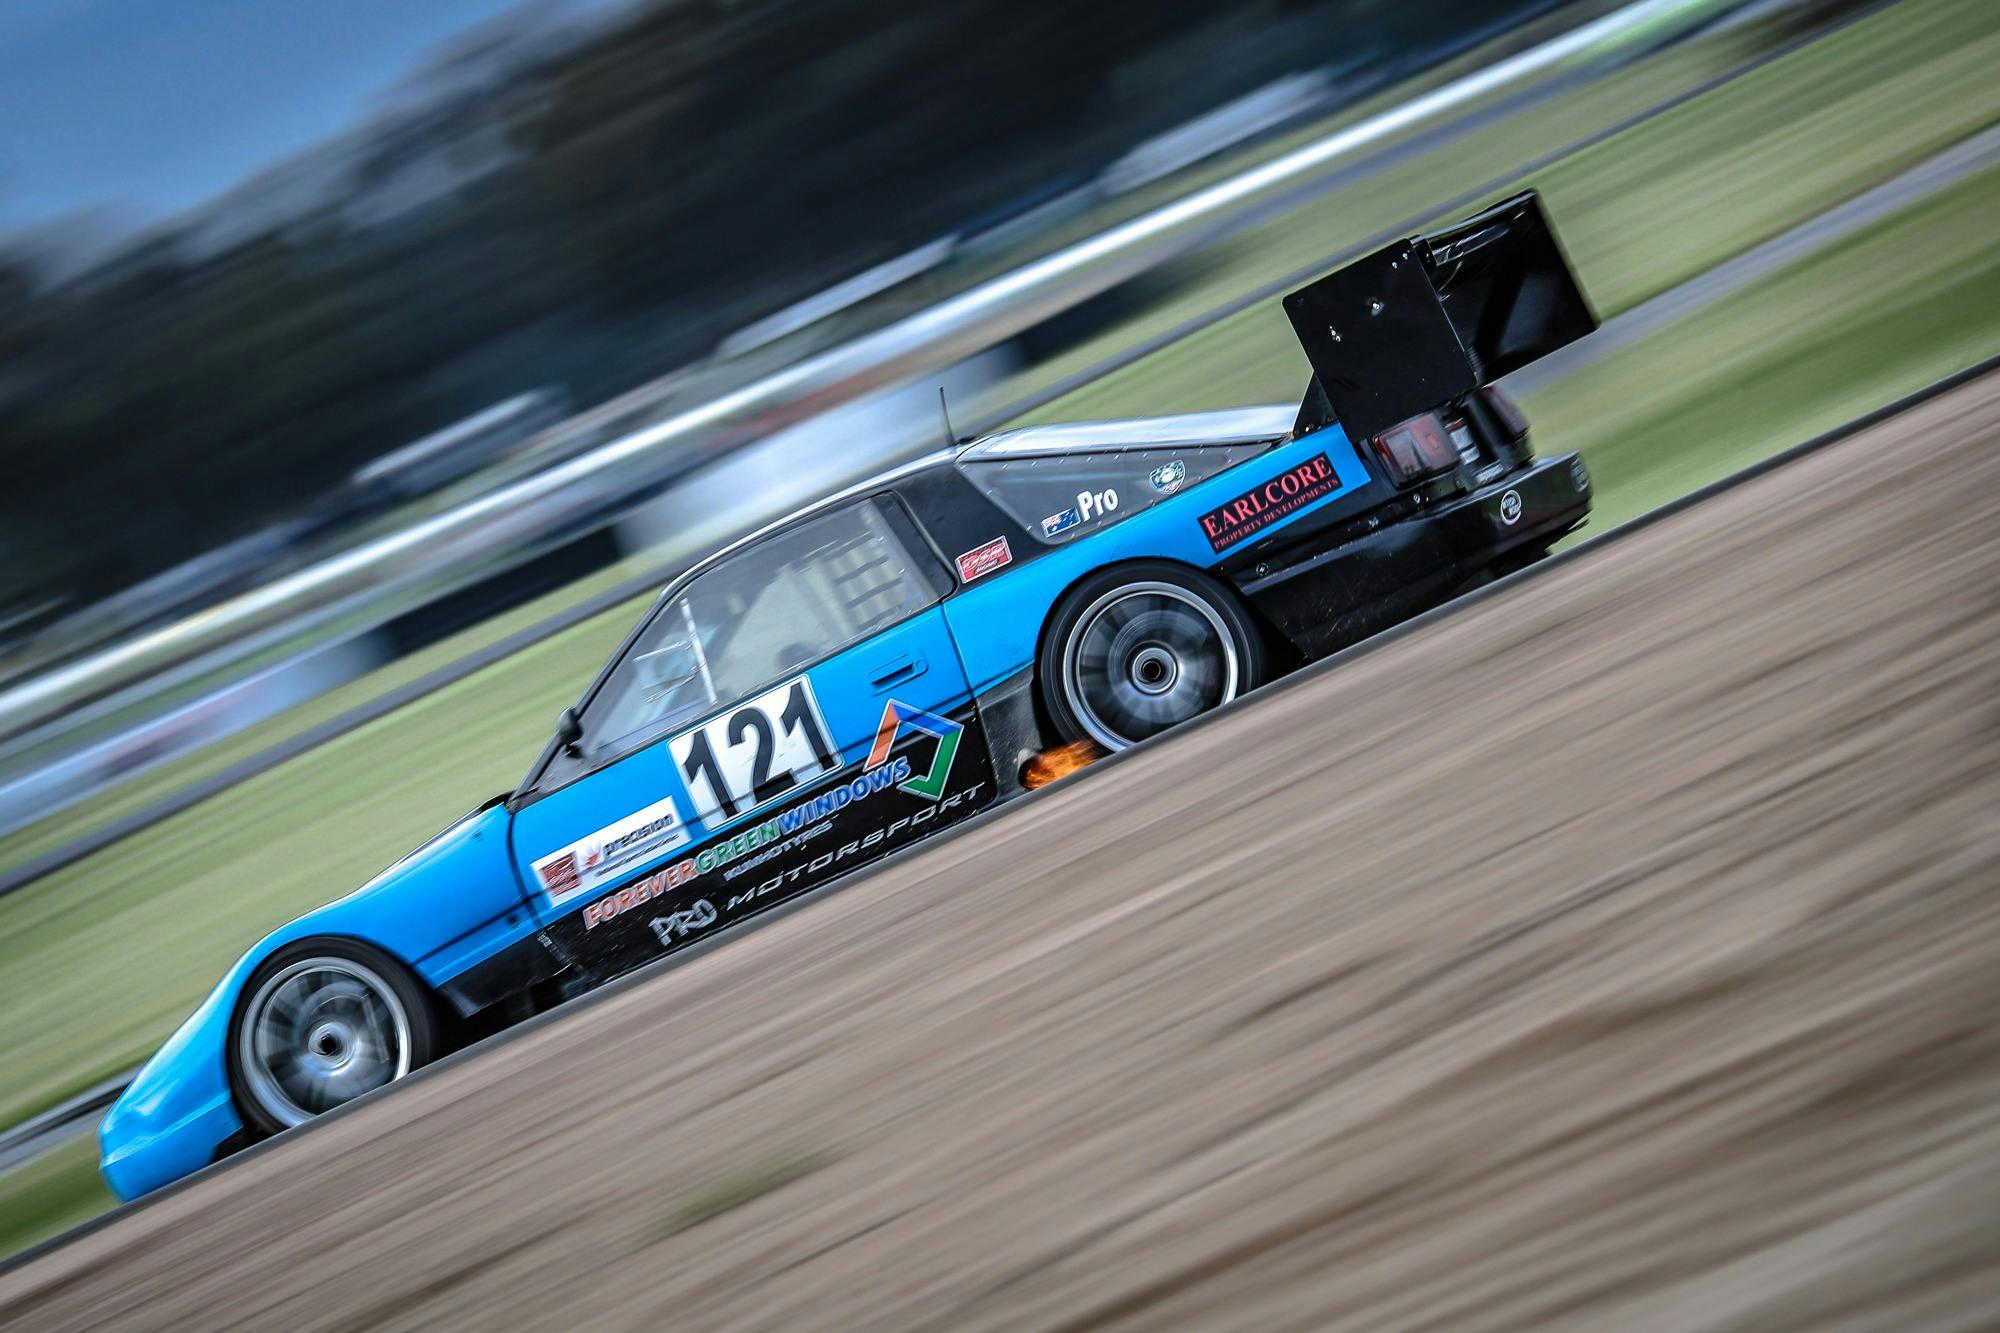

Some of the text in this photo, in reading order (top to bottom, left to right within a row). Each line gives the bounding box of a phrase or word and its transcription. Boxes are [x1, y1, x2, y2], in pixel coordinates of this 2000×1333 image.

[1077, 487, 1119, 521] Pro
[1203, 457, 1332, 538] EARLCORE
[1213, 478, 1340, 550] PROPERTY DEVELOPMENTS
[684, 680, 838, 822] 121
[648, 898, 719, 947] PRO
[726, 781, 986, 911] MOTORSPORT
